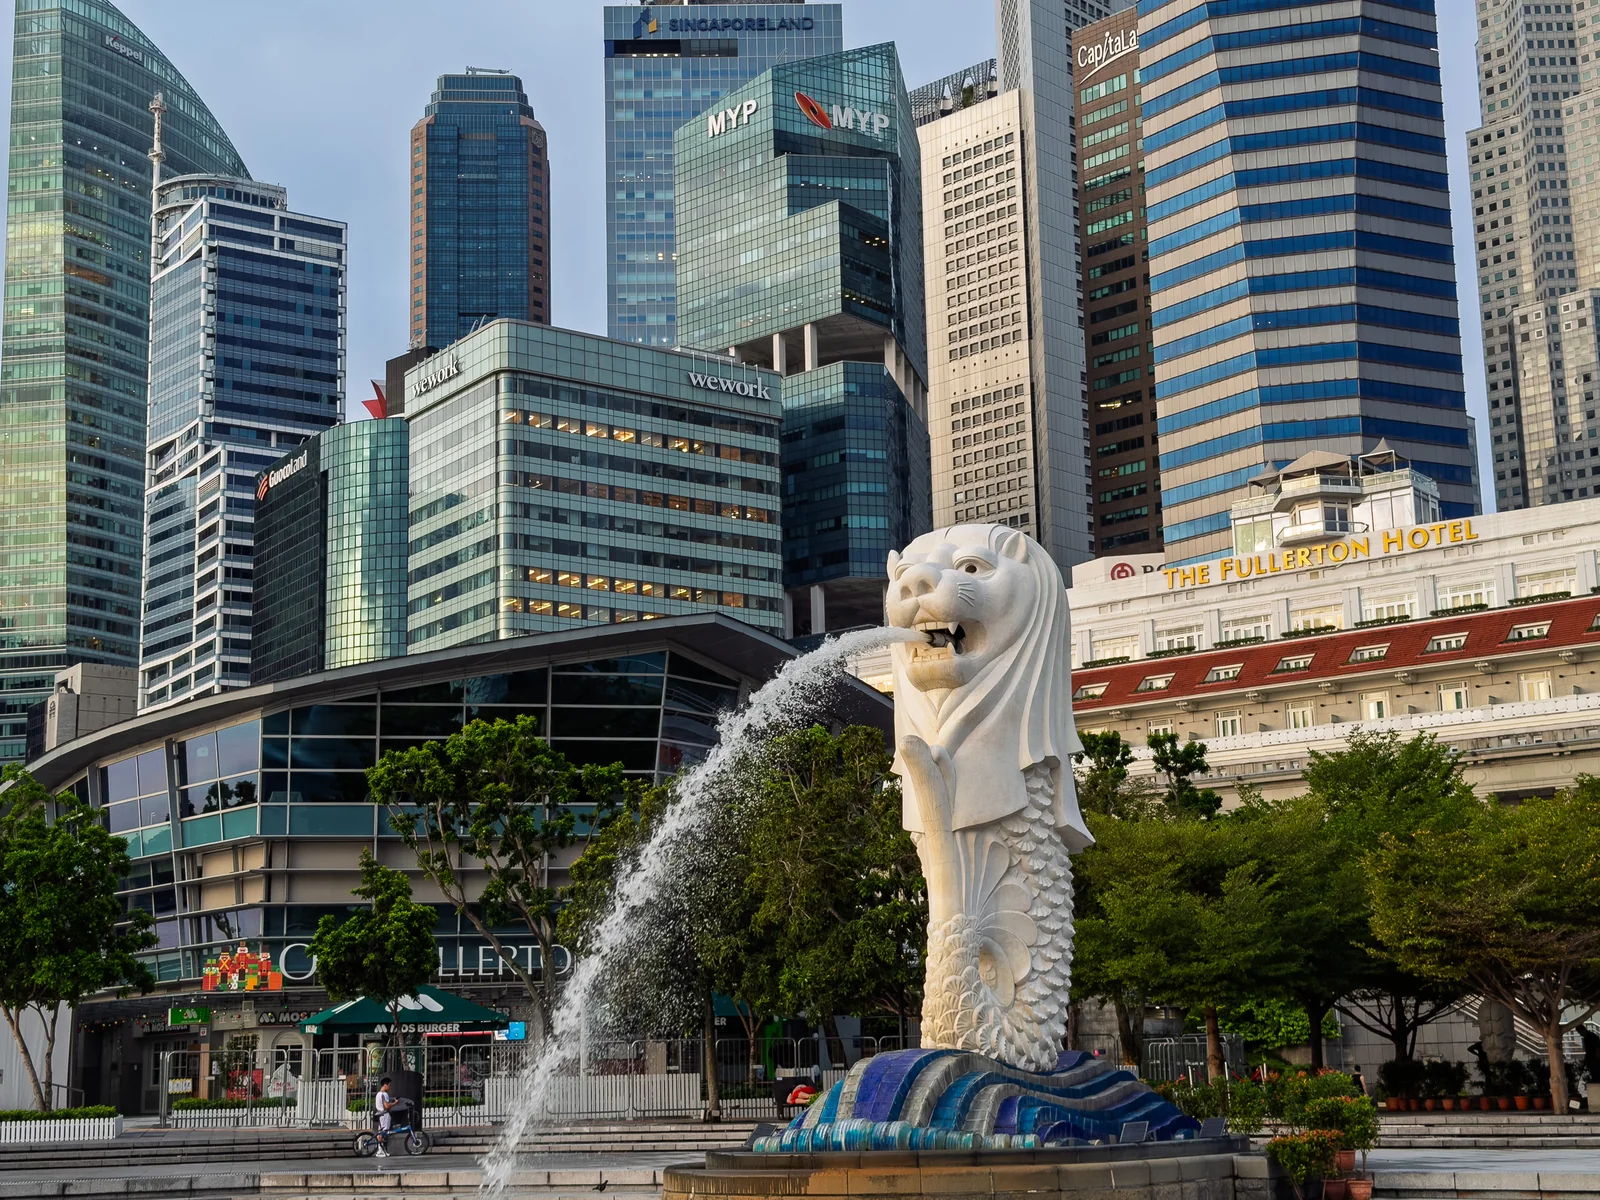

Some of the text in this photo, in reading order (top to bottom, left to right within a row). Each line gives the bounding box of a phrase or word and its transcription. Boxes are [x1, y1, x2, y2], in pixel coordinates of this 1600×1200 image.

[668, 17, 814, 32] SINGAPORELAND
[105, 35, 143, 61] Keppel
[1077, 29, 1138, 68] CapitaLa
[708, 99, 758, 138] MYP
[832, 104, 890, 135] MYP
[412, 353, 459, 398] wework
[687, 371, 772, 400] wework
[268, 449, 308, 488] GuocoLand
[1162, 519, 1478, 590] THE FULLERTON HOTEL
[417, 1023, 460, 1033] BURGER
